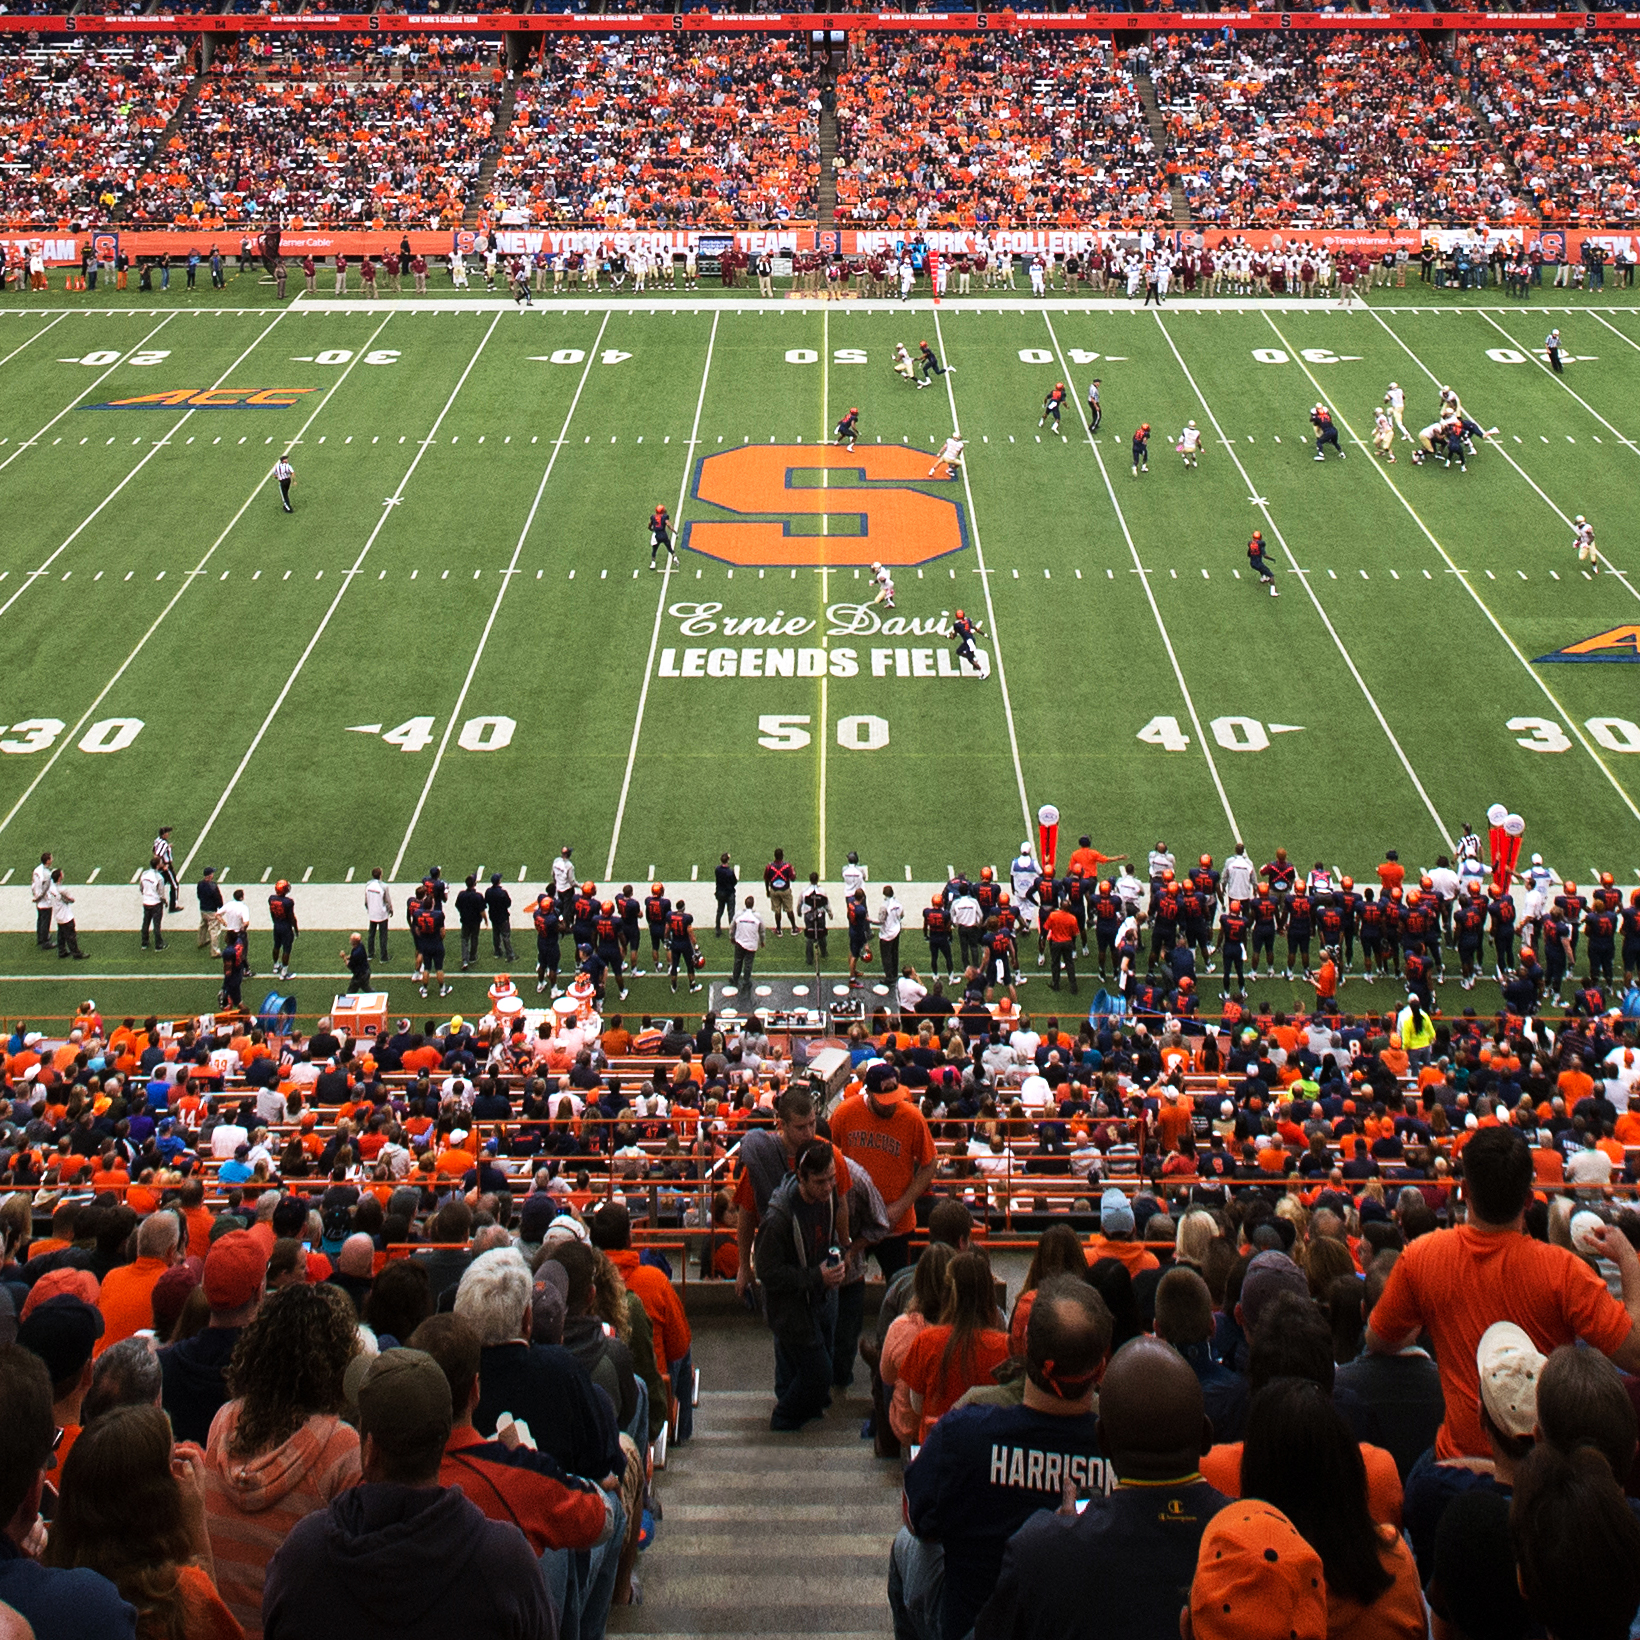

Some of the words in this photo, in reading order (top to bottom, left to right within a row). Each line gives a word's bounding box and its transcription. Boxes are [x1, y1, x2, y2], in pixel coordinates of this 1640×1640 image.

[66, 16, 77, 31] S
[495, 232, 534, 254] NEW
[551, 232, 630, 254] YORK'S
[737, 232, 796, 254] TEAM
[1334, 236, 1356, 245] Time
[1357, 237, 1388, 246] Warner
[1390, 236, 1416, 246] Cable
[106, 388, 324, 407] ACC
[680, 444, 970, 568] S
[668, 602, 816, 636] Ernie
[658, 648, 860, 678] LEGENDS
[379, 714, 518, 752] 40
[757, 715, 890, 750] 50
[1135, 714, 1274, 752] 40
[847, 1130, 902, 1158] SYRACUSE
